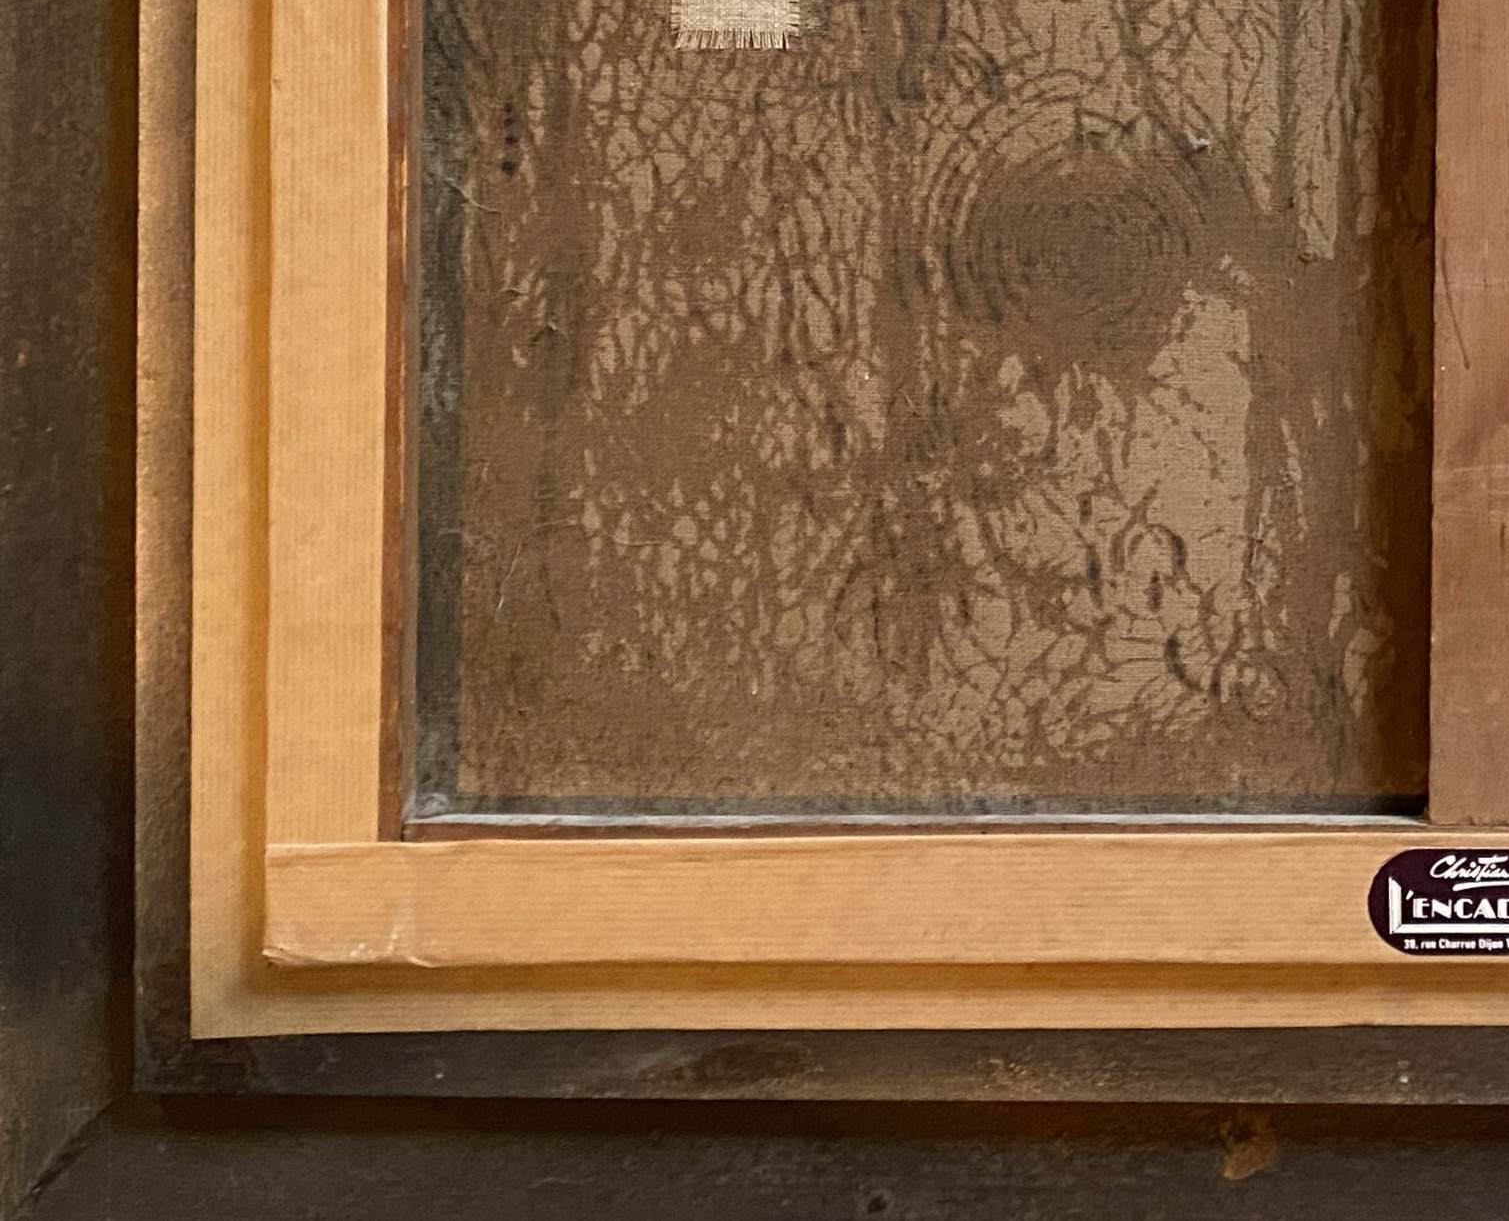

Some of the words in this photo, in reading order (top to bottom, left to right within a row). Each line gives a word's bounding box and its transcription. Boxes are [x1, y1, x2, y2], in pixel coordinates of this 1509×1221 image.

[1420, 940, 1437, 949] rue
[1438, 938, 1477, 950] Charrue
[1478, 938, 1504, 951] Dijon
